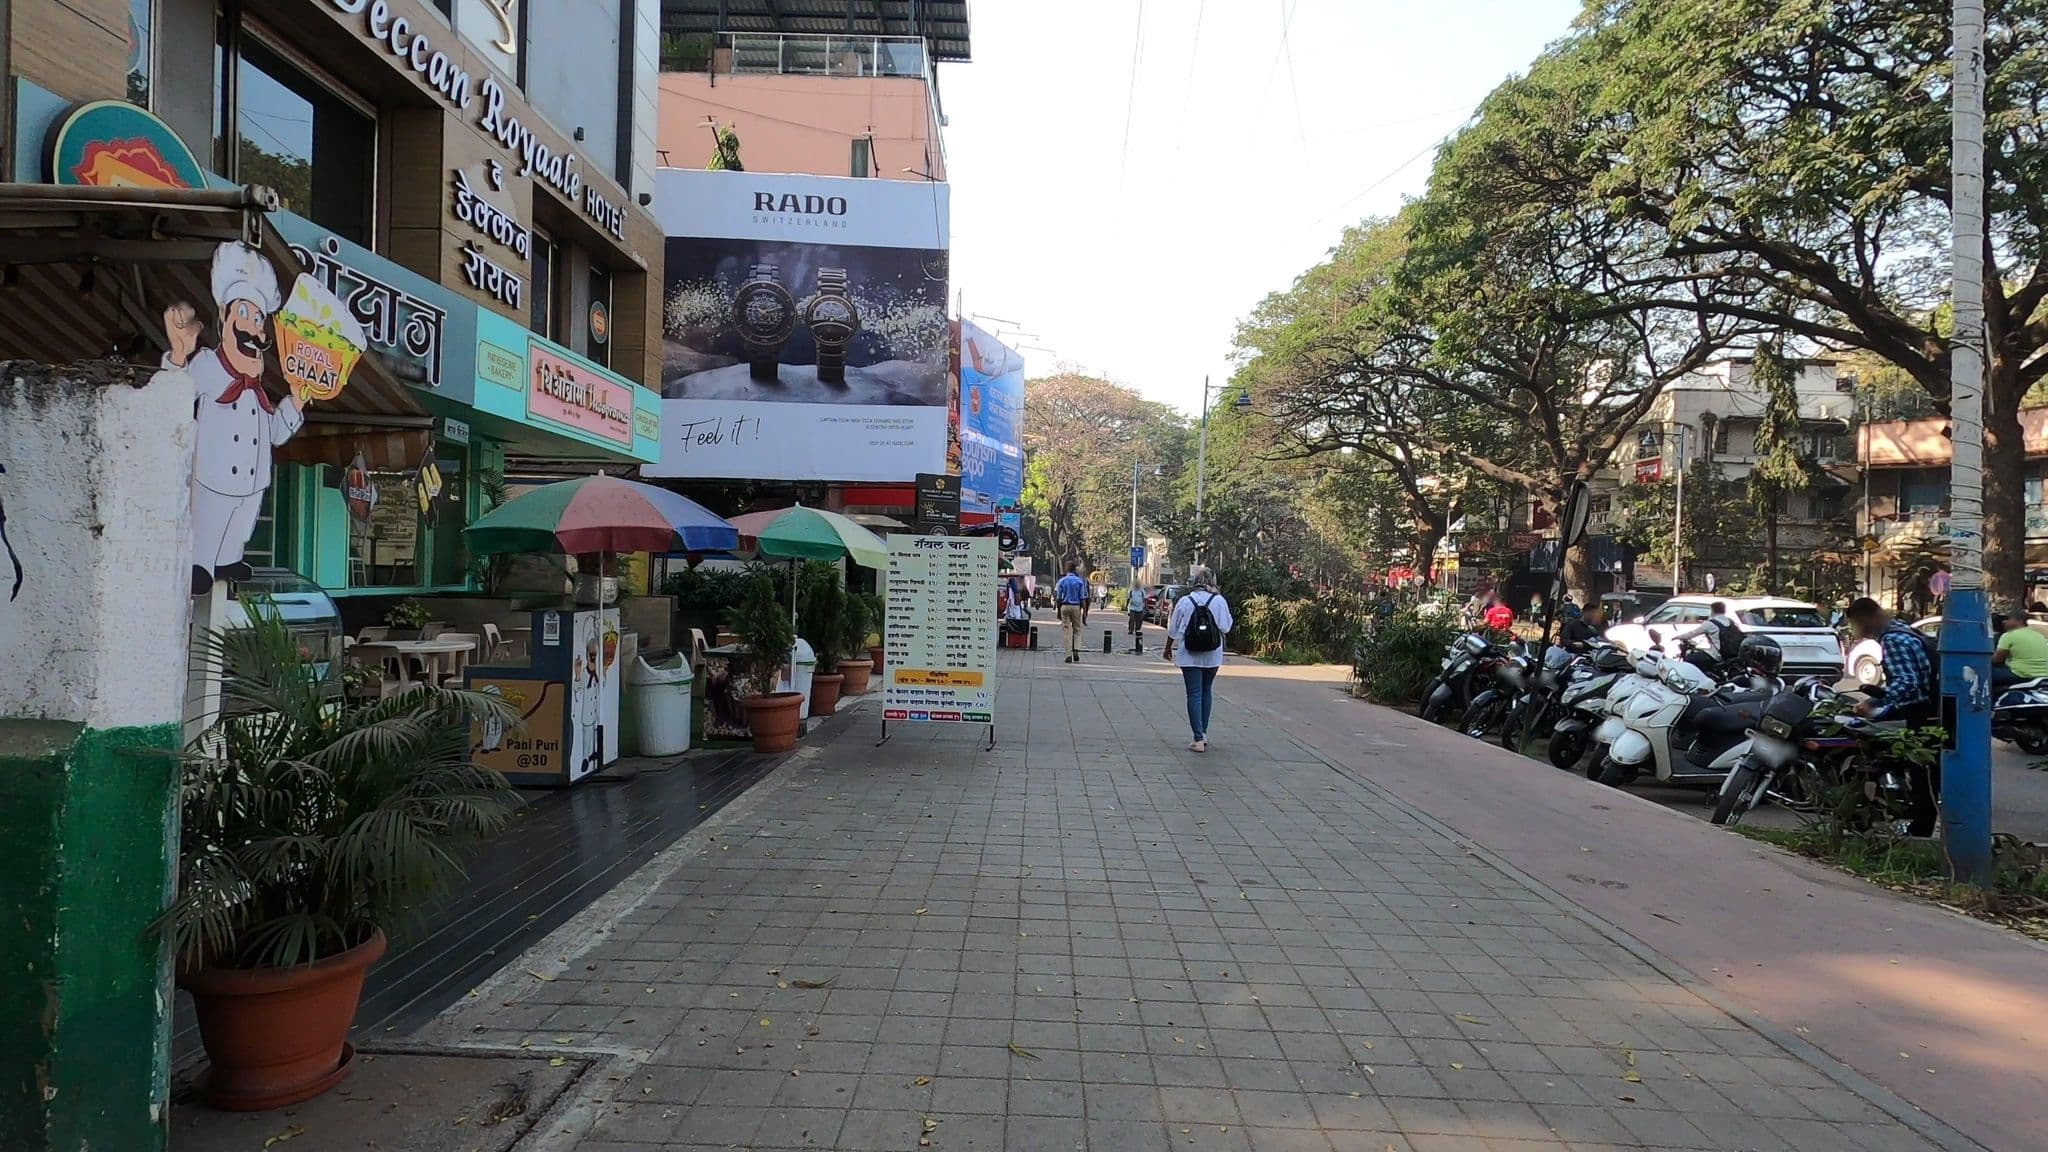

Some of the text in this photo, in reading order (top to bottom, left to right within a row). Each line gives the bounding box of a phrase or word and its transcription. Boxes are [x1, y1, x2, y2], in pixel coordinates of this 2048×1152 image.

[481, 73, 580, 201] Royaale
[585, 185, 625, 241] HOTEL
[488, 159, 503, 191] द
[456, 169, 529, 259] डेक्कन
[753, 191, 847, 216] RADO
[752, 216, 848, 229] SWITZERLAND
[464, 241, 521, 309] रॉयल
[296, 342, 332, 369] ROYAL
[286, 356, 338, 391] CHAAT
[681, 417, 724, 453] Feel
[914, 538, 971, 550] रॉयल चाट
[506, 738, 559, 752] Pani Puri
[516, 754, 548, 768] @30
